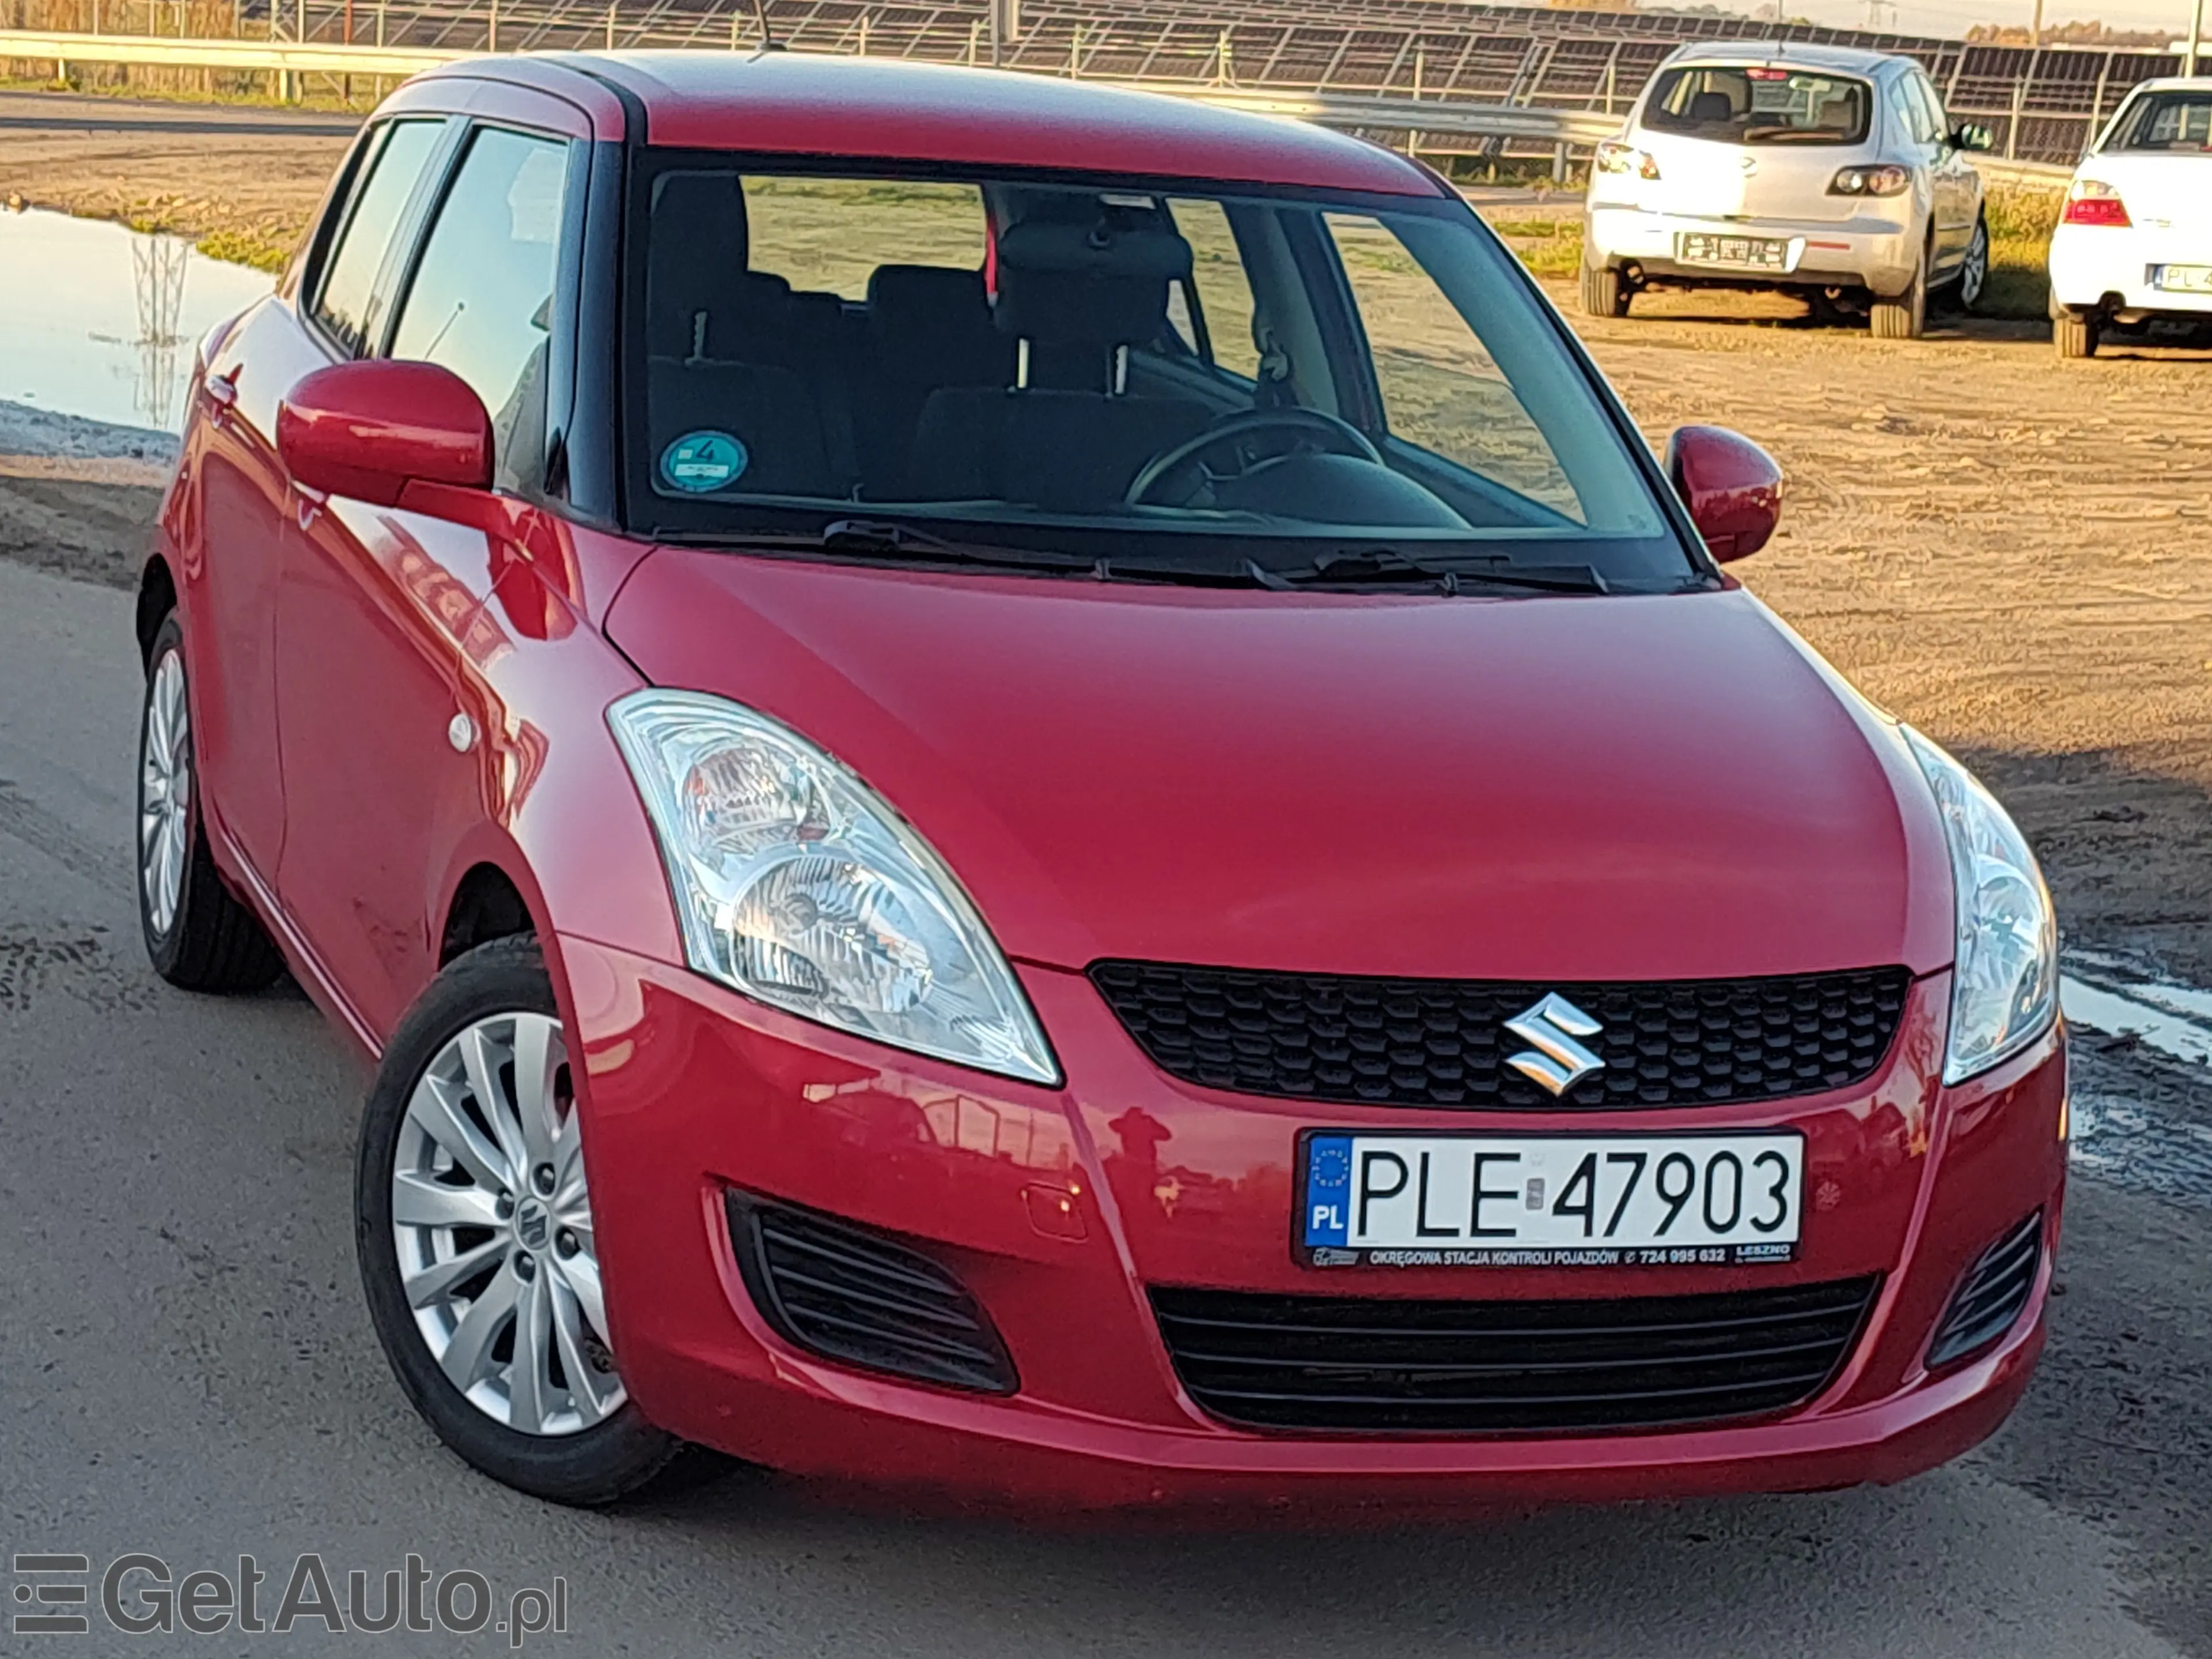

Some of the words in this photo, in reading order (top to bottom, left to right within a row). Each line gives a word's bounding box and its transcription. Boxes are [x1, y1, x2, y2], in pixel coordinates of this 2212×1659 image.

[696, 440, 714, 460] 4
[1357, 1150, 1521, 1237] PLE
[1552, 1150, 1789, 1237] 47903
[1312, 1204, 1344, 1230] PL
[1370, 1250, 1442, 1268] OKRĘGOWA
[1444, 1251, 1490, 1265] STACJA
[1554, 1248, 1619, 1265] POJAZDÓW
[1639, 1249, 1666, 1264] 724
